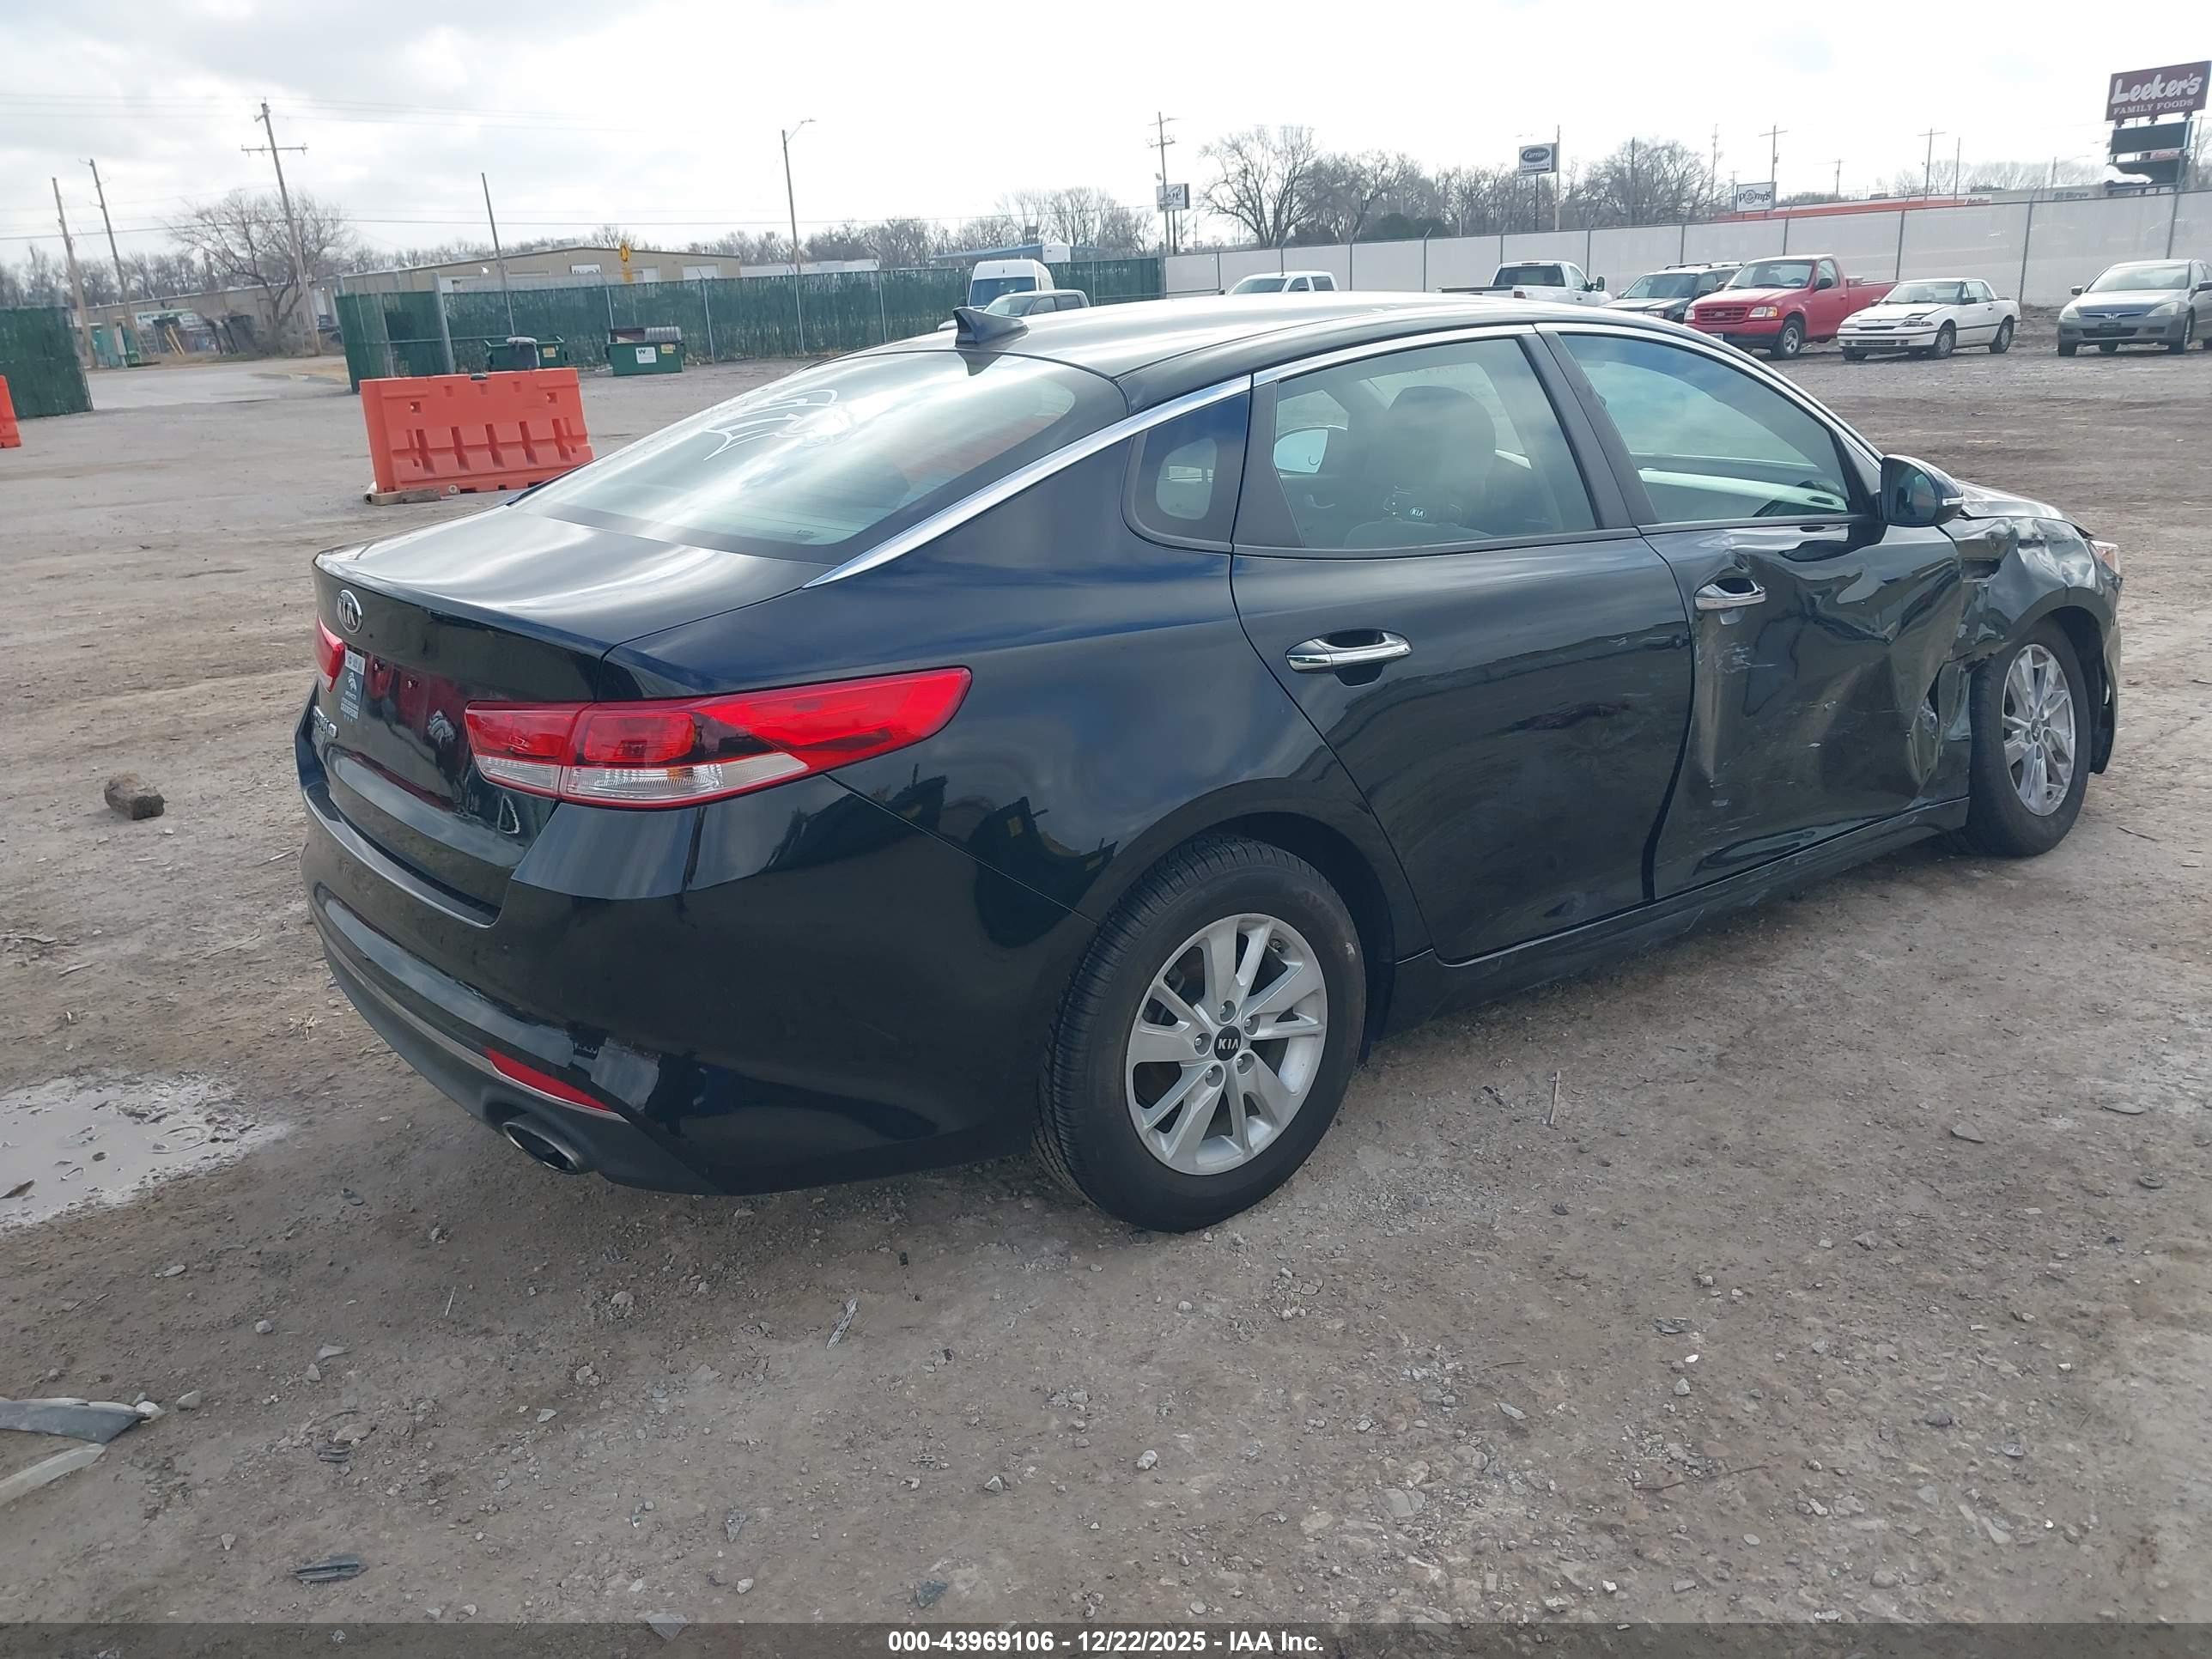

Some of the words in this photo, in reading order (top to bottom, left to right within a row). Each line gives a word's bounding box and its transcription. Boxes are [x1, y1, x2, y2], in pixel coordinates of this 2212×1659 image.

[2111, 73, 2203, 104] Leeker's
[2113, 103, 2154, 115] FAMILY
[2156, 98, 2194, 111] FOODS
[1218, 1038, 1239, 1049] KIA
